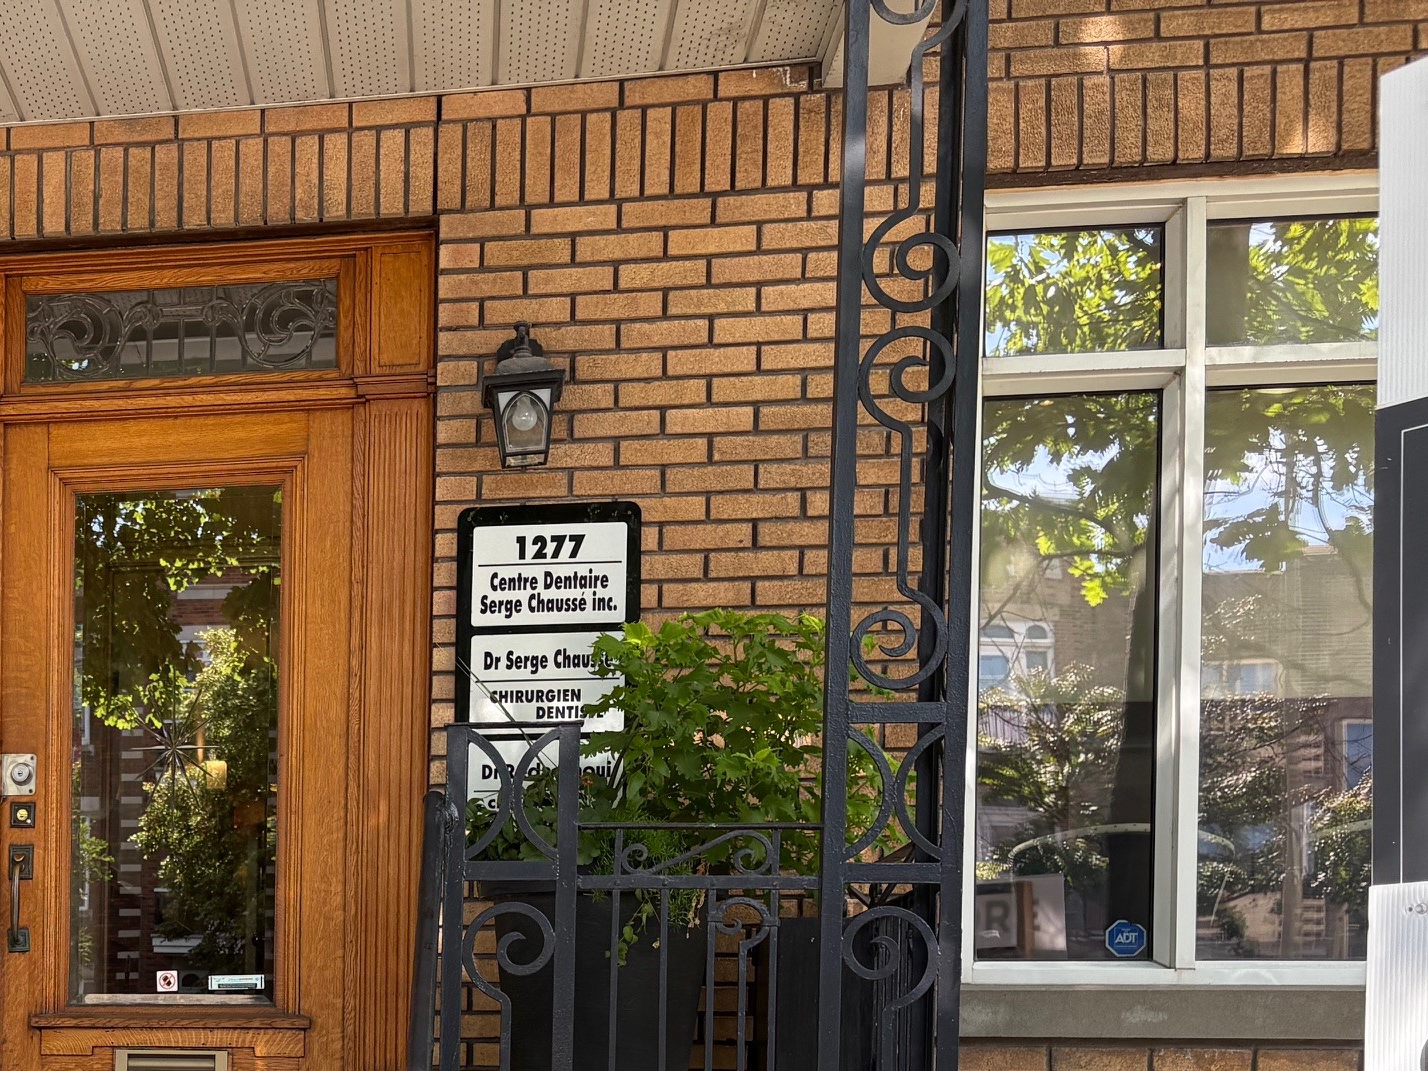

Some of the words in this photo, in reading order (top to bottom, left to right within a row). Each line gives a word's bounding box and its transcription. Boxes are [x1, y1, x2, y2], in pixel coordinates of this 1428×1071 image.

[516, 534, 586, 560] 1277
[490, 572, 538, 592] Centre
[543, 569, 609, 590] Dentaire
[480, 595, 522, 618] Serge
[528, 591, 586, 613] Chaussé
[592, 594, 617, 611] inc.
[483, 652, 501, 670] Dr
[506, 650, 548, 674] Serge
[490, 689, 582, 703] CHIRURGIEN
[535, 705, 604, 719] DENTIS
[1115, 932, 1138, 943] ADT
